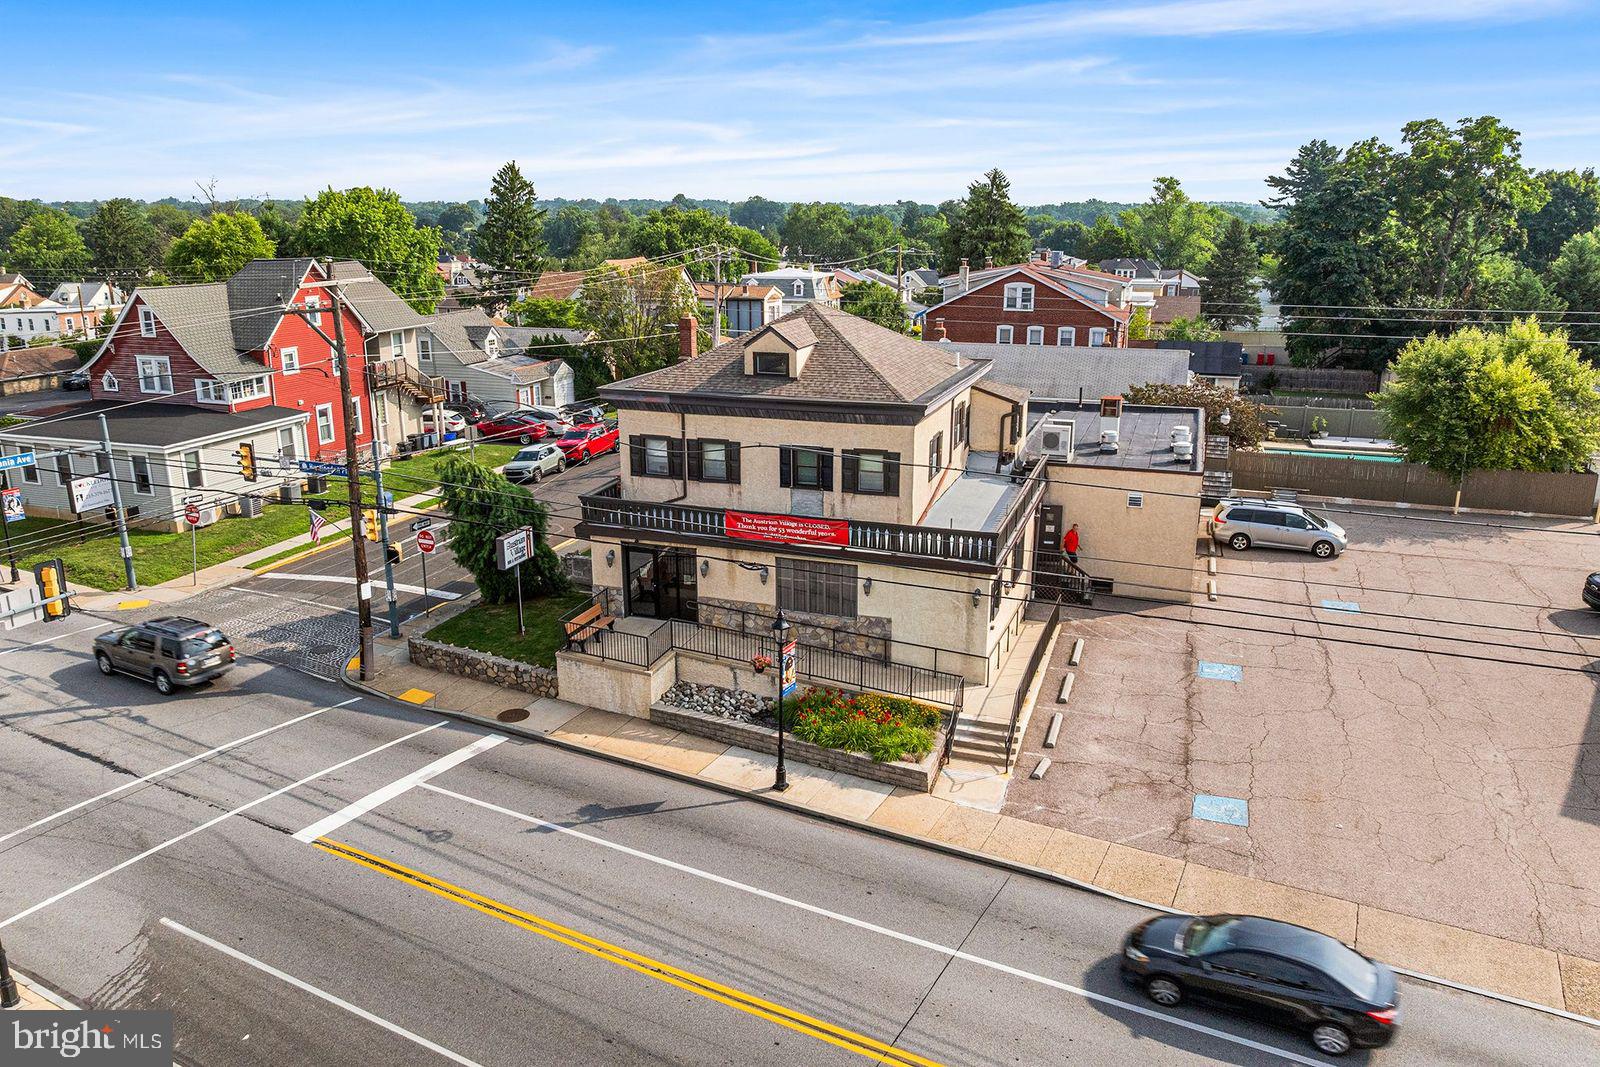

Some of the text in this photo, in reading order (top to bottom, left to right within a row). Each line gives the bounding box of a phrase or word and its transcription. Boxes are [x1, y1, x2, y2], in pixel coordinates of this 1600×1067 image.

[17, 455, 31, 465] Ave
[736, 522, 756, 530] Thank
[786, 528, 816, 536] wonderful
